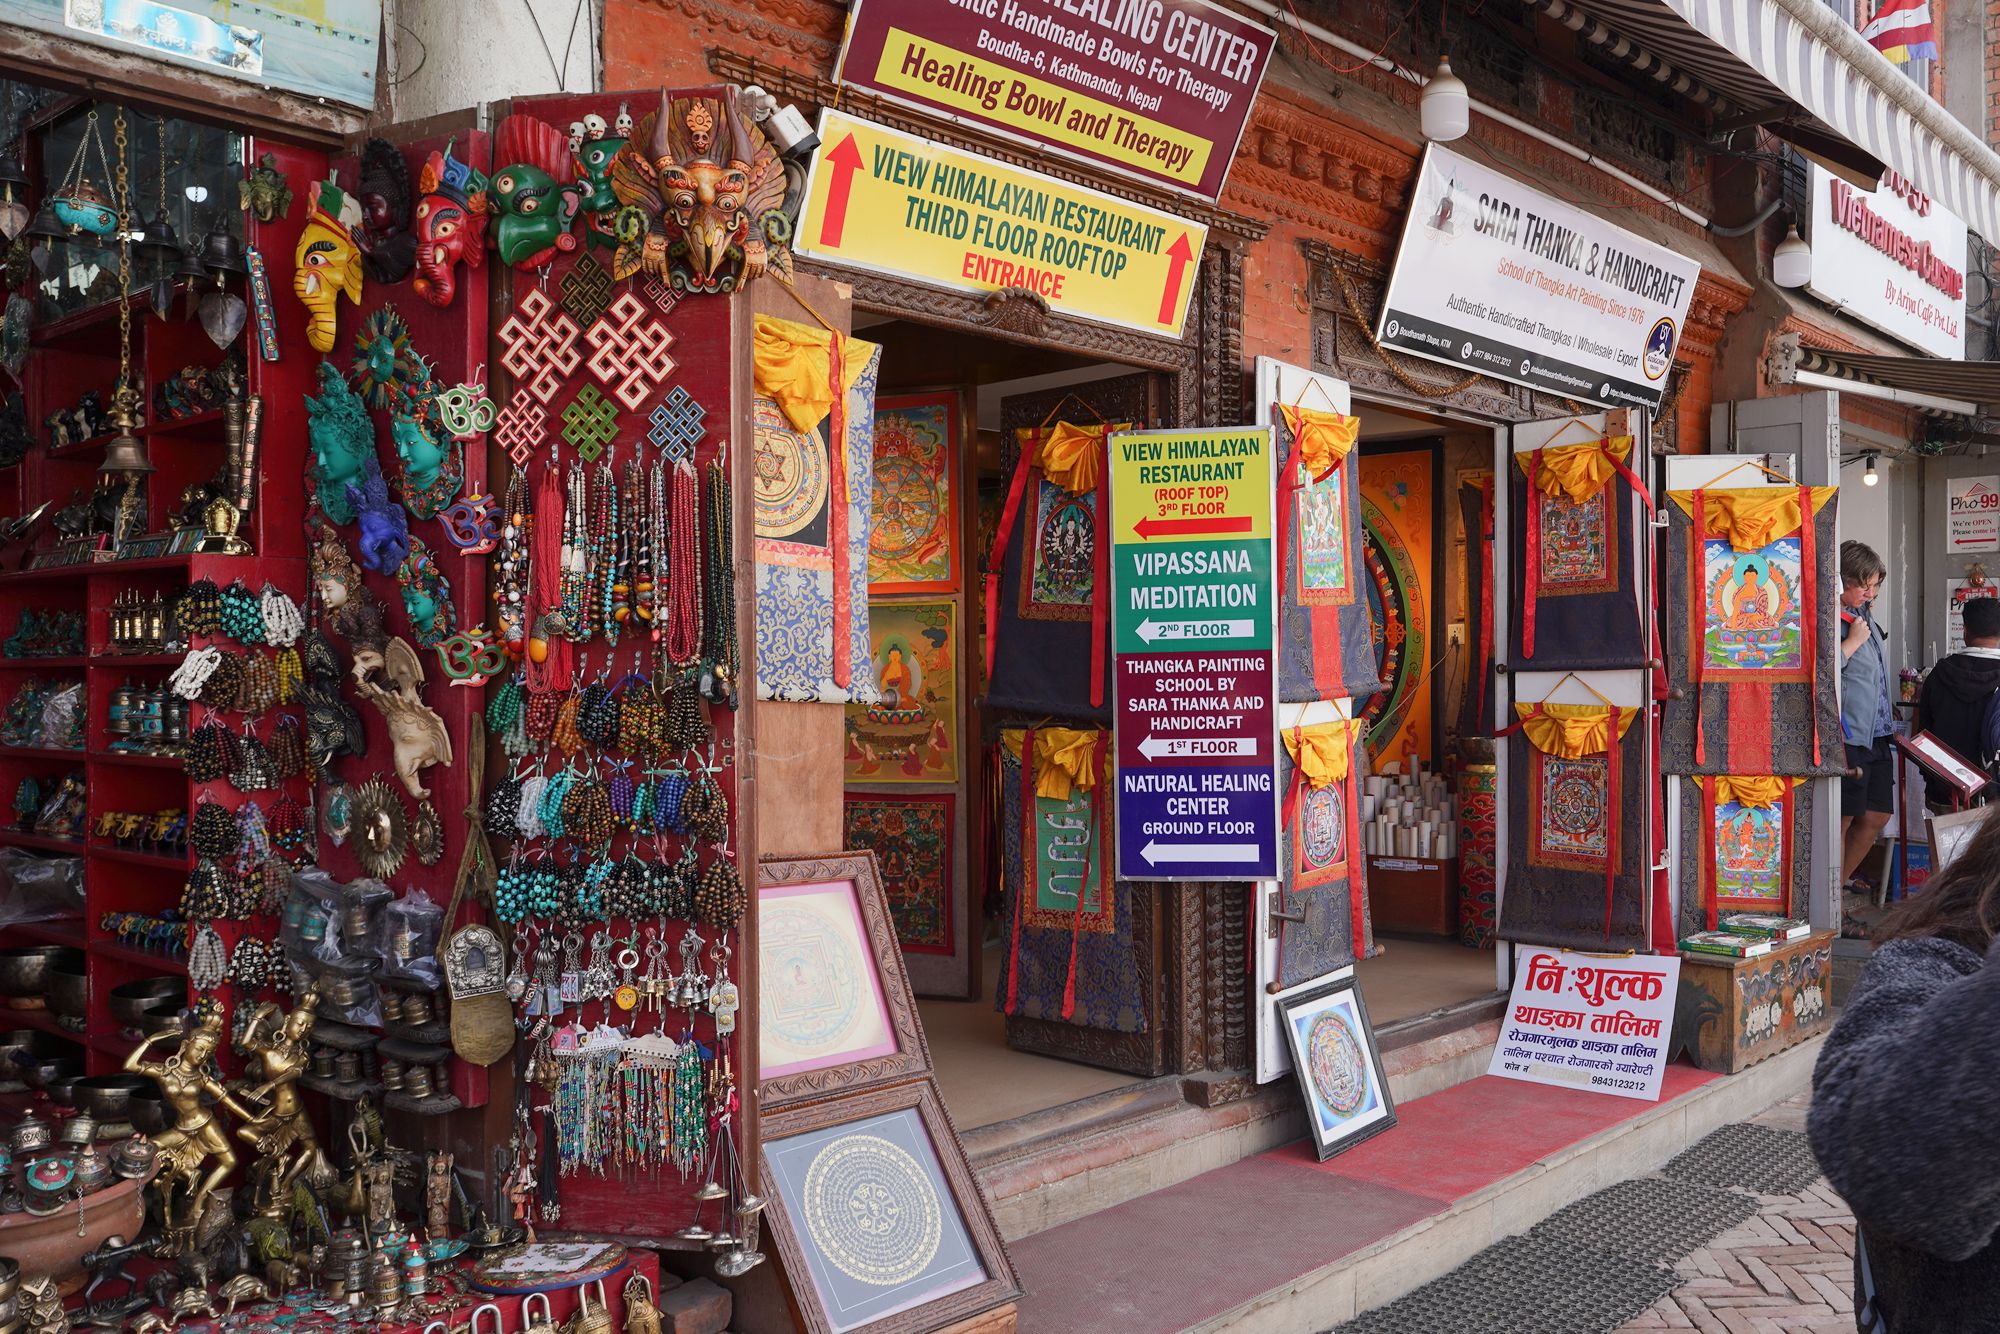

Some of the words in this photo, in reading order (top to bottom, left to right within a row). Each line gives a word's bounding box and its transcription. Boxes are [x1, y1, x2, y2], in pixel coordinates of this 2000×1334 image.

[1000, 0, 1096, 56] Handmade
[1098, 37, 1147, 75] Bowls
[1148, 57, 1175, 87] For
[1176, 68, 1232, 113] Therapy
[1163, 10, 1258, 84] CENTER
[977, 29, 1046, 74] Boudha-6,
[1050, 56, 1123, 103] Kathmandu,
[1126, 84, 1163, 112] Nepal
[901, 43, 1005, 110] Healing
[1004, 80, 1067, 125] Bowl
[1066, 108, 1112, 141] and
[1113, 116, 1194, 173] Therapy
[873, 144, 927, 189] VIEW
[930, 158, 1049, 225] HIMALAYAN
[1050, 198, 1166, 255] RESTAURANT
[904, 196, 970, 242] THIRD
[973, 215, 1038, 260] FLOOR
[1040, 233, 1127, 280] ROOFTOP
[1830, 178, 1919, 271] Vietnamese
[1918, 240, 1963, 301] Cuisine
[1474, 193, 1520, 246] SARA
[1522, 213, 1584, 270] THANKA
[1585, 242, 1599, 278] &
[1600, 247, 1685, 309] HANDICRAFT
[961, 252, 1065, 299] ENTRANCE
[1498, 257, 1524, 281] School
[1524, 267, 1534, 285] of
[1535, 270, 1565, 297] Thangka
[1565, 282, 1578, 301] Art
[1579, 290, 1608, 315] Painting
[1608, 299, 1627, 318] Since
[1628, 308, 1645, 326] 1976
[1885, 279, 1896, 305] By
[1896, 287, 1916, 315] Ariya
[1917, 298, 1934, 326] Café
[1934, 308, 1945, 331] Pvt.
[1946, 316, 1958, 338] Ltd.
[1447, 294, 1487, 319] Authentic
[1488, 306, 1535, 336] Handicrafted
[1537, 318, 1572, 348] Thangkas
[1577, 335, 1613, 360] Wholesale
[1617, 349, 1639, 368] Export
[1122, 442, 1163, 462] VIEW
[1168, 437, 1260, 460] HIMALAYAN
[1140, 461, 1244, 484] RESTAURANT
[1154, 487, 1195, 503] (ROOF
[1198, 485, 1229, 501] TOP)
[1158, 503, 1178, 517] 3RD
[1181, 502, 1225, 516] FLOOR
[1133, 549, 1252, 576] VIPASSANA
[1130, 583, 1257, 610] MEDITATION
[1158, 624, 1179, 637] 2ND
[1183, 623, 1230, 637] FLOOR
[1126, 659, 1194, 674] THANGKA
[1198, 657, 1265, 673] PAINTING
[1155, 678, 1213, 692] SCHOOL
[1217, 677, 1236, 691] BY
[1128, 698, 1168, 712] SARA
[1171, 697, 1229, 711] THANKA
[1233, 696, 1264, 710] AND
[1150, 716, 1243, 731] HANDICRAFT
[1167, 740, 1187, 754] 1ST
[1191, 741, 1238, 754] FLOOR
[1125, 775, 1197, 793] NATURAL
[1201, 774, 1271, 792] HEALING
[1166, 798, 1229, 816] CENTER
[1142, 822, 1204, 835] GROUND
[1208, 822, 1255, 835] FLOOR
[1514, 1005, 1585, 1031] थाङ्का
[1590, 1010, 1662, 1038] तालिम
[1503, 1046, 1532, 1059] तालिम
[1567, 1054, 1614, 1070] रोजगारको
[1621, 1043, 1658, 1059] तालिम
[1504, 1062, 1520, 1072] फोन
[1592, 1076, 1646, 1091] 9843123212
